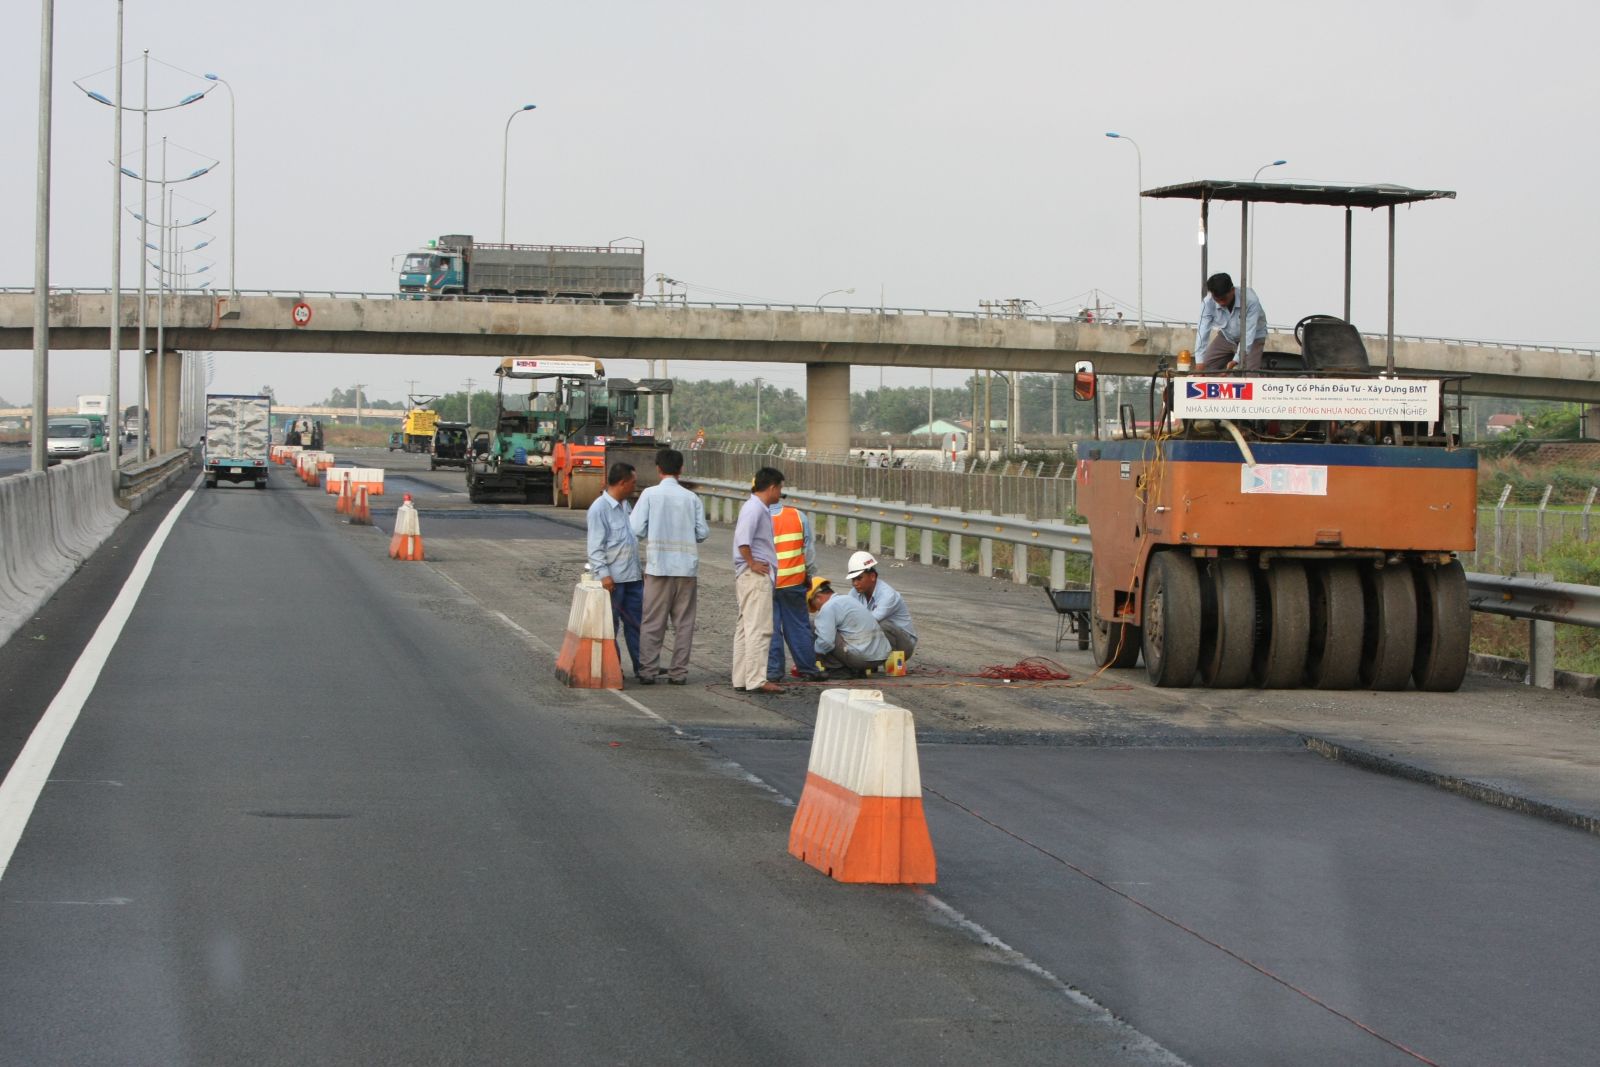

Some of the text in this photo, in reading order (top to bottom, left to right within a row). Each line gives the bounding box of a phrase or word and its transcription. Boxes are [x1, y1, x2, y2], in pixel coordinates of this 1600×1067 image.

[1262, 383, 1283, 394] Công
[1286, 384, 1295, 393] Ty
[1296, 383, 1308, 392] Cổ
[1309, 383, 1330, 393] Phần
[1332, 384, 1349, 393] Đầu
[1351, 385, 1361, 393] Tư
[1367, 385, 1383, 394] Xây
[1385, 385, 1407, 395] Dựng
[1409, 385, 1427, 393] BMT
[1185, 405, 1202, 413] NHÀ
[1248, 406, 1270, 414] CUNG
[1298, 405, 1319, 414] TÔNG
[1369, 407, 1398, 416] CHUYÊN
